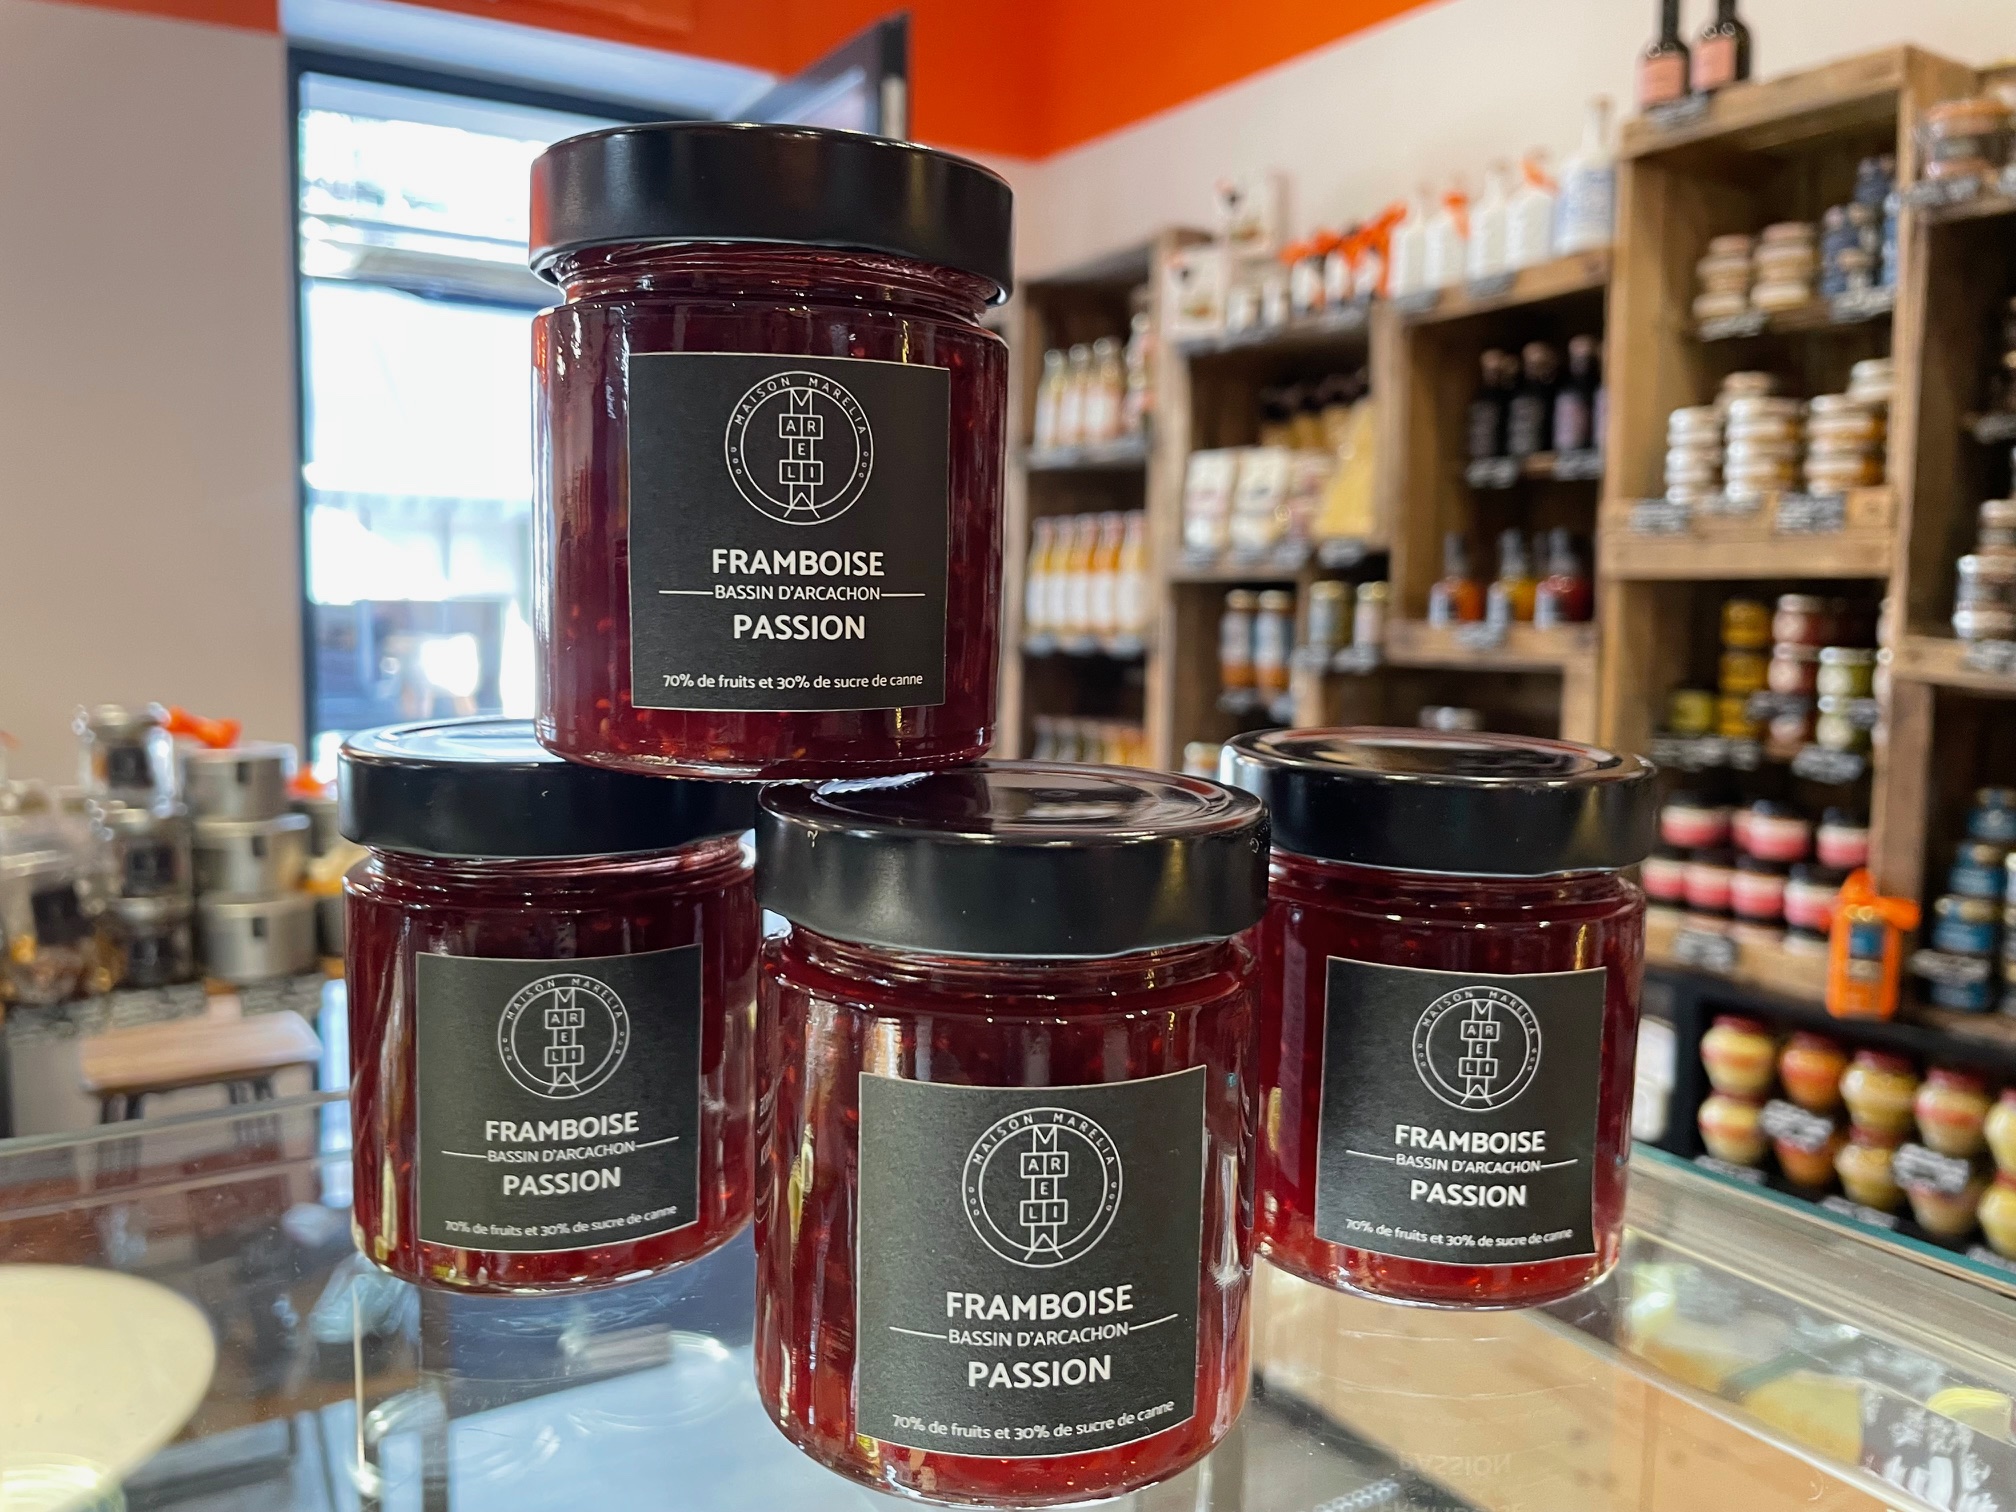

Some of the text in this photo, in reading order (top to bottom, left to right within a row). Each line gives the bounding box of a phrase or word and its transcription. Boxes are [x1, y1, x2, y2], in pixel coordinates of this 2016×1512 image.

[734, 376, 866, 434] MAISON MARELIA
[712, 549, 884, 576] FRAMBOISE
[715, 586, 880, 600] BASSIN D'ARCACHON
[734, 615, 865, 639] PASSION
[663, 674, 922, 689] 70% de fruits et 30% de sucre de canne
[506, 978, 623, 1021] MAISON MARELIA
[486, 1111, 639, 1142] FRAMBOISE
[974, 1112, 1114, 1166] MAISON MARELIA
[1395, 1125, 1546, 1154] FRAMBOISE
[488, 1141, 636, 1163] BASSIN D'ARCACHON
[1396, 1154, 1541, 1174] BASSIN D'ARCACHON
[503, 1167, 621, 1195] PASSION
[1410, 1180, 1526, 1206] PASSION
[472, 1223, 488, 1234] de
[490, 1224, 522, 1237] fruits
[525, 1225, 538, 1236] et
[540, 1224, 570, 1235] 30%
[573, 1221, 589, 1233] de
[591, 1218, 624, 1230] sucre
[626, 1213, 641, 1225] de
[1376, 1224, 1393, 1236] de
[1395, 1228, 1427, 1242] fruits
[1430, 1232, 1443, 1244] et
[1446, 1235, 1475, 1246] 30%
[1478, 1235, 1493, 1247] de
[1496, 1236, 1526, 1246] sucre
[1528, 1232, 1542, 1244] de
[947, 1285, 1133, 1321] FRAMBOISE
[948, 1321, 1129, 1346] BASSIN D'ARCACHON
[968, 1355, 1111, 1388] PASSION
[892, 1401, 1174, 1440] 70% de fruits et 30% de sucre de canne
